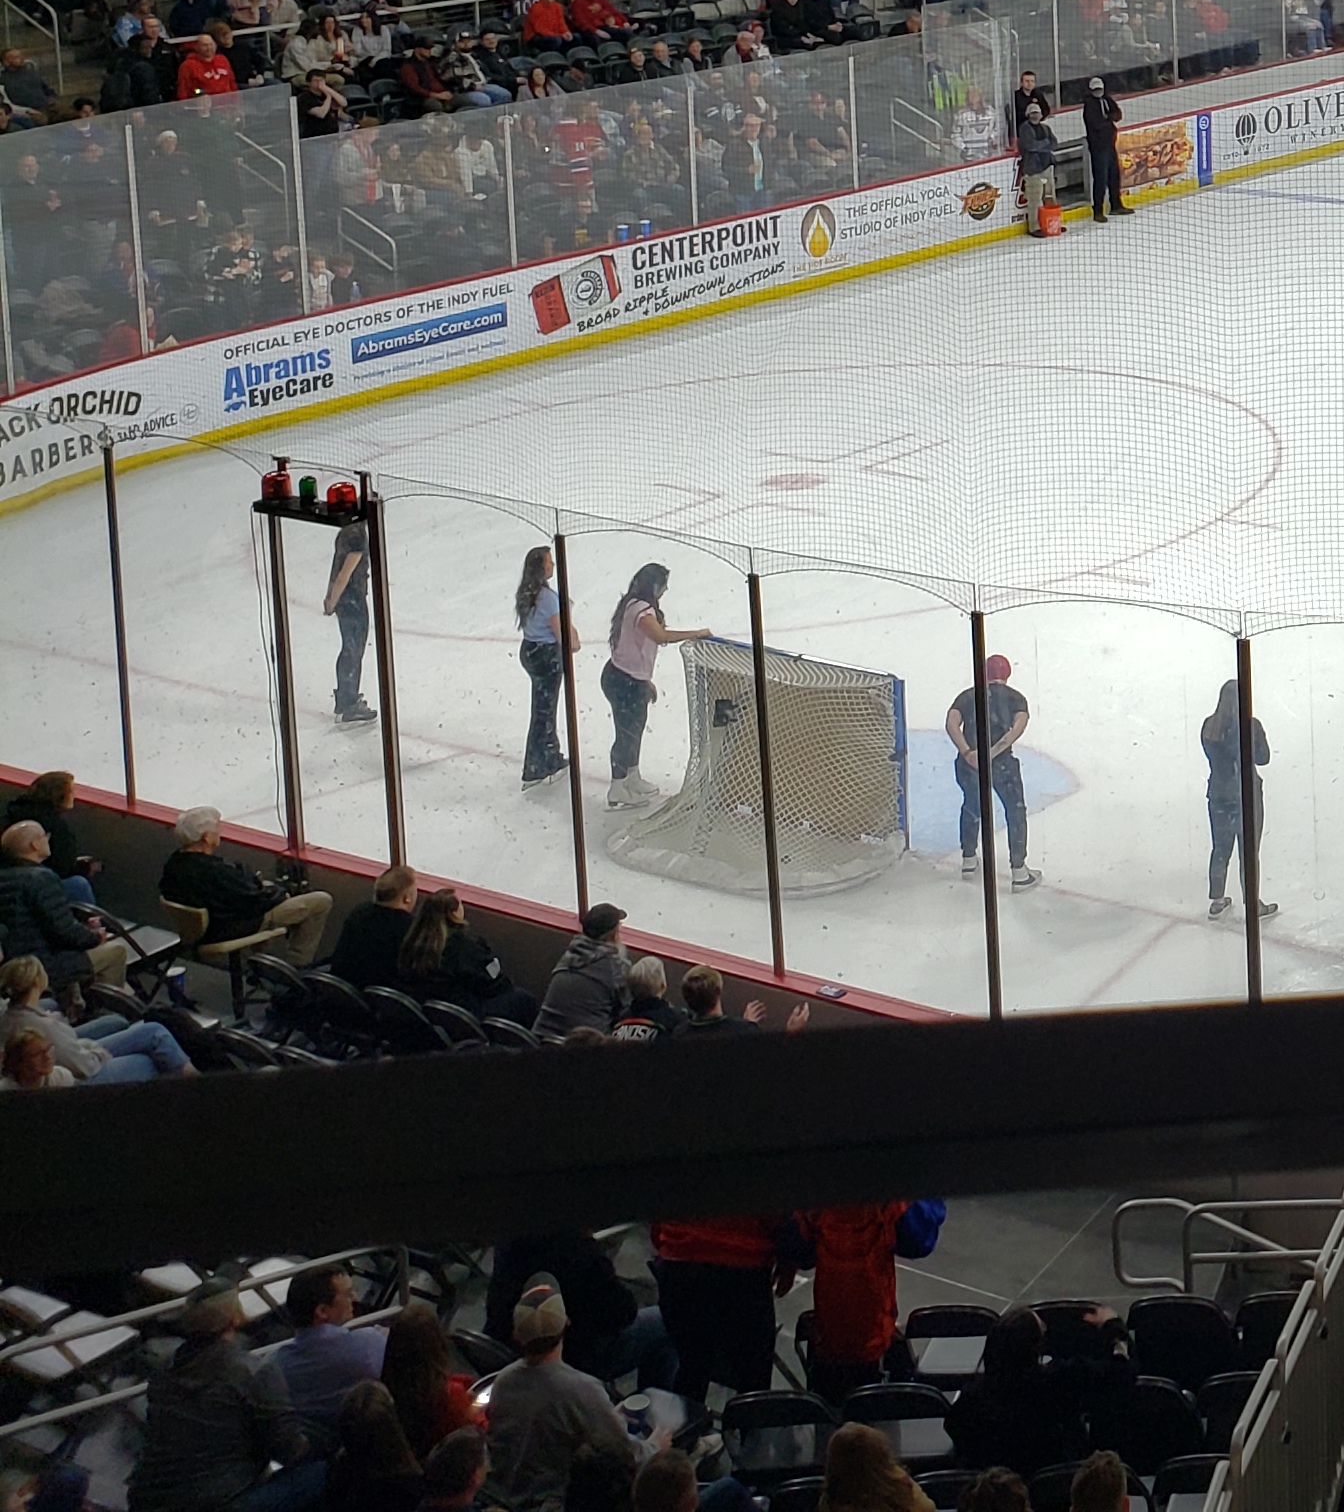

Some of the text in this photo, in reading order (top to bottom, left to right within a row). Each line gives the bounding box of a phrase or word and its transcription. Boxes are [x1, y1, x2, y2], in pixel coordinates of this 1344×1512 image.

[840, 221, 883, 240] STUDIO
[884, 216, 899, 229] OF
[900, 209, 927, 226] INDY
[929, 202, 956, 218] FUEL
[845, 185, 950, 219] THE OFFICIAL YOGA
[632, 215, 782, 271] CENTERPOINT
[634, 241, 781, 290] BREWING COMPANY
[719, 261, 787, 297] LOCATIONS
[576, 307, 621, 333] BROAD
[624, 286, 670, 313] RIPPLE
[655, 274, 726, 313] DOWNTOWN
[223, 283, 514, 361] OFFICIAL EYE DOCTORS OF THE INDY FUEL
[356, 311, 503, 358] AbramsEyeCare.com
[223, 348, 332, 402] Abrams
[248, 371, 335, 408] EyeCare
[50, 389, 142, 425] ORCHID
[143, 413, 178, 435] ADVICE
